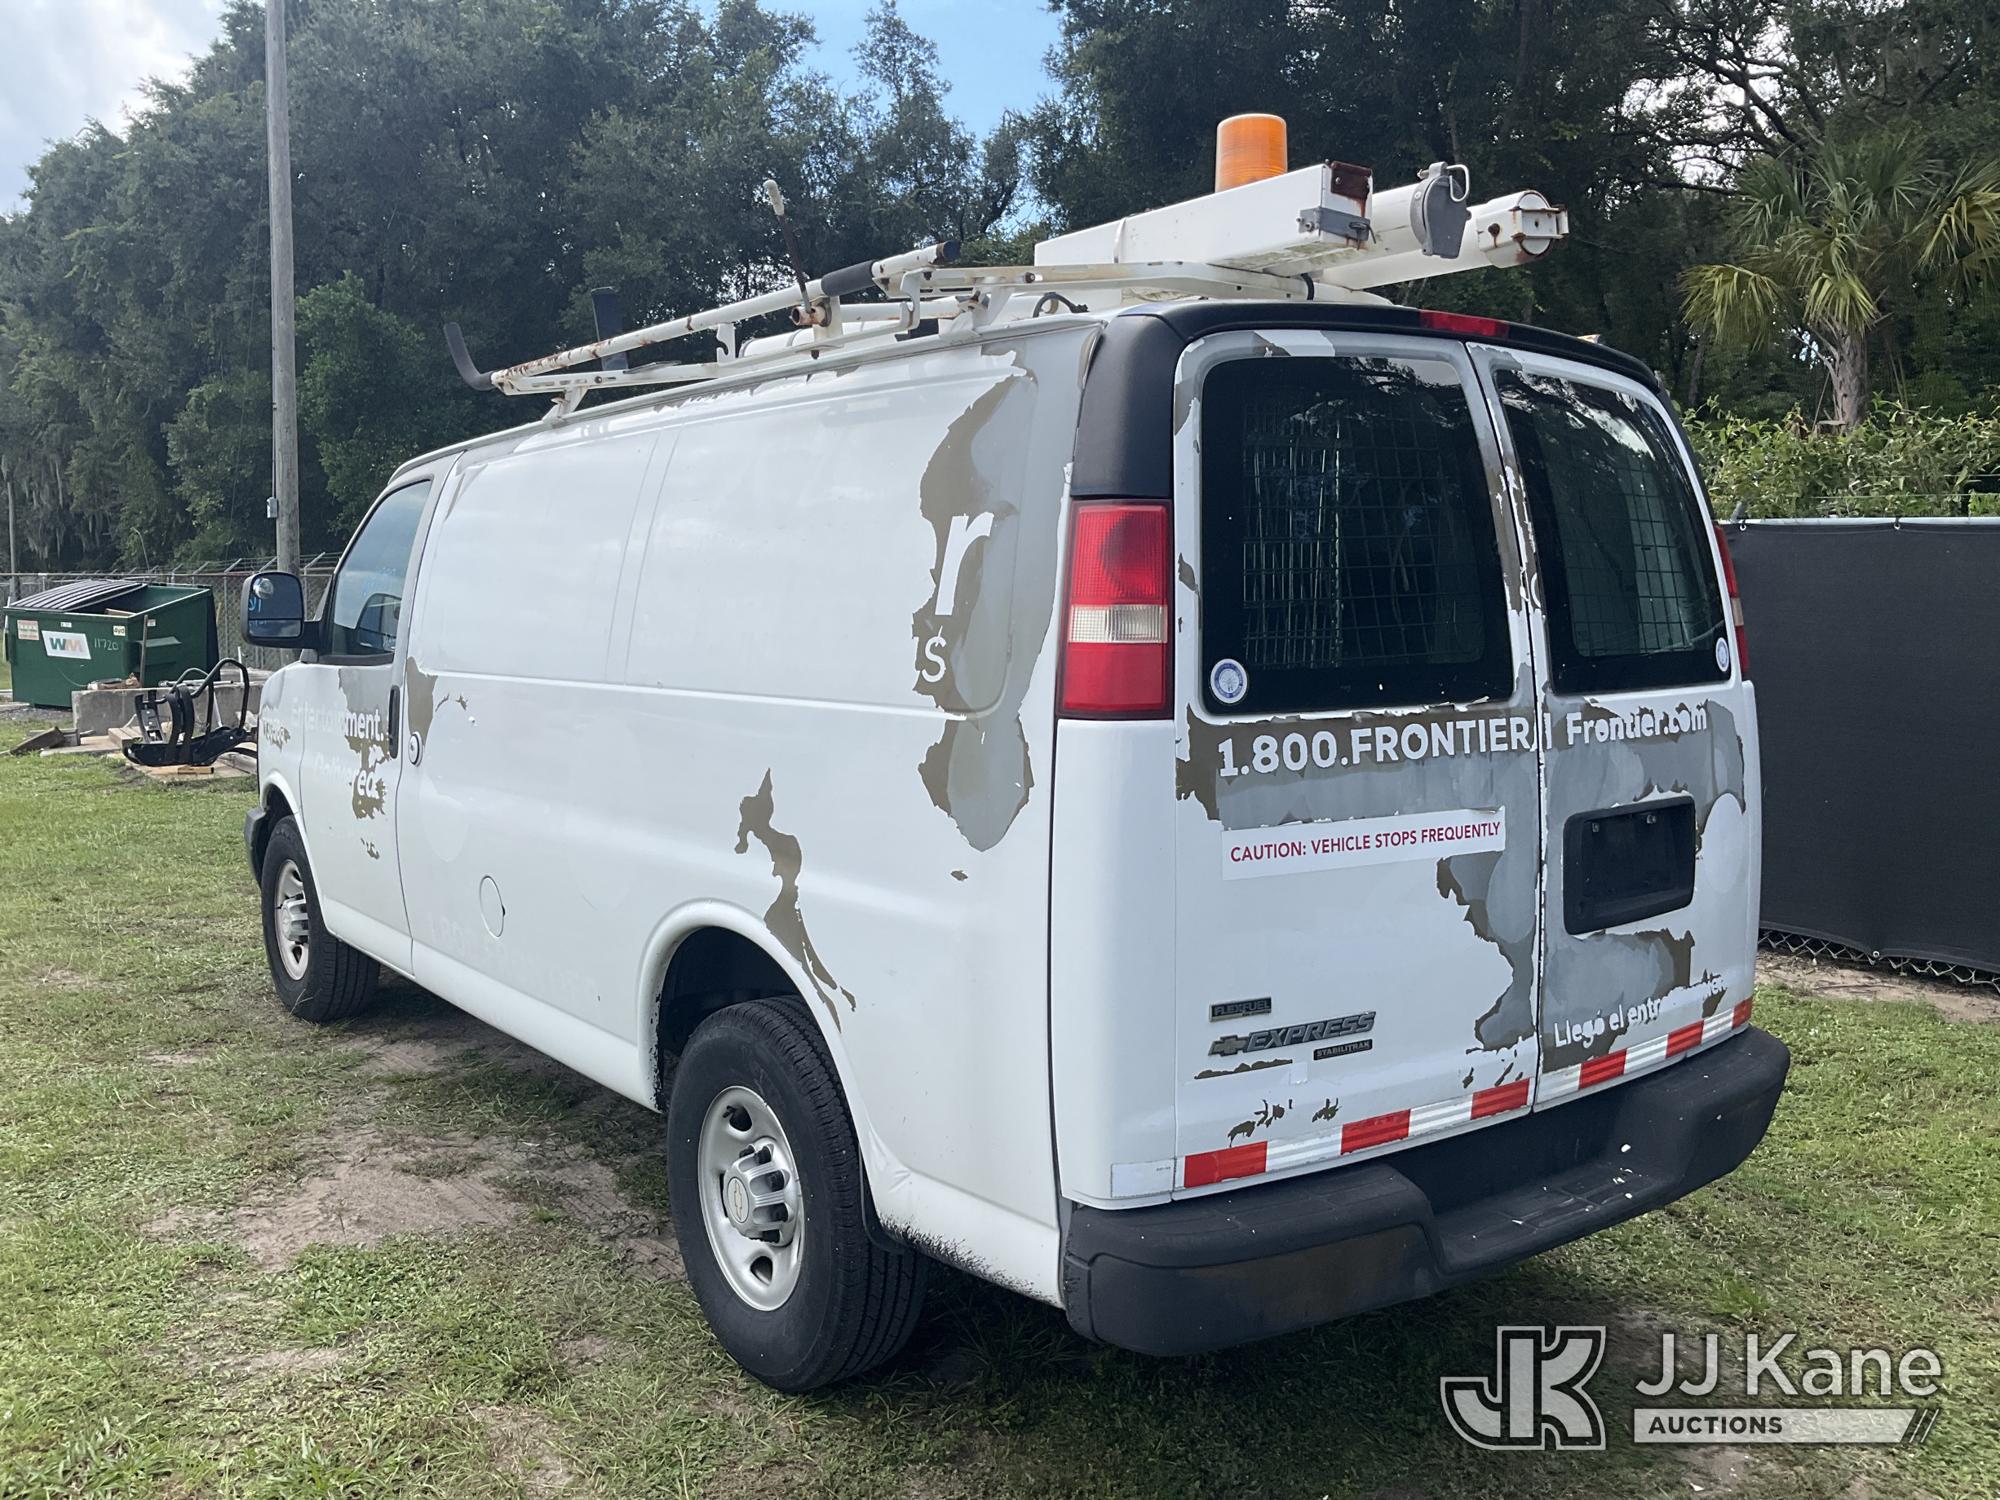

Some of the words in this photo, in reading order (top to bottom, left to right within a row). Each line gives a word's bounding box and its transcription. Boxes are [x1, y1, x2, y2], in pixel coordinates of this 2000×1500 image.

[50, 637, 83, 652] WM
[1218, 716, 1531, 778] 1.800.FRONTIER
[1566, 705, 1707, 746] Frontier.com
[1230, 841, 1307, 862] CAUTION:
[1311, 834, 1371, 855] VEHICLE
[1375, 830, 1417, 849] STOPS
[1421, 821, 1501, 842] FREQUENTLY
[1248, 1012, 1376, 1051] EXPRESS
[1609, 1004, 1625, 1028] el
